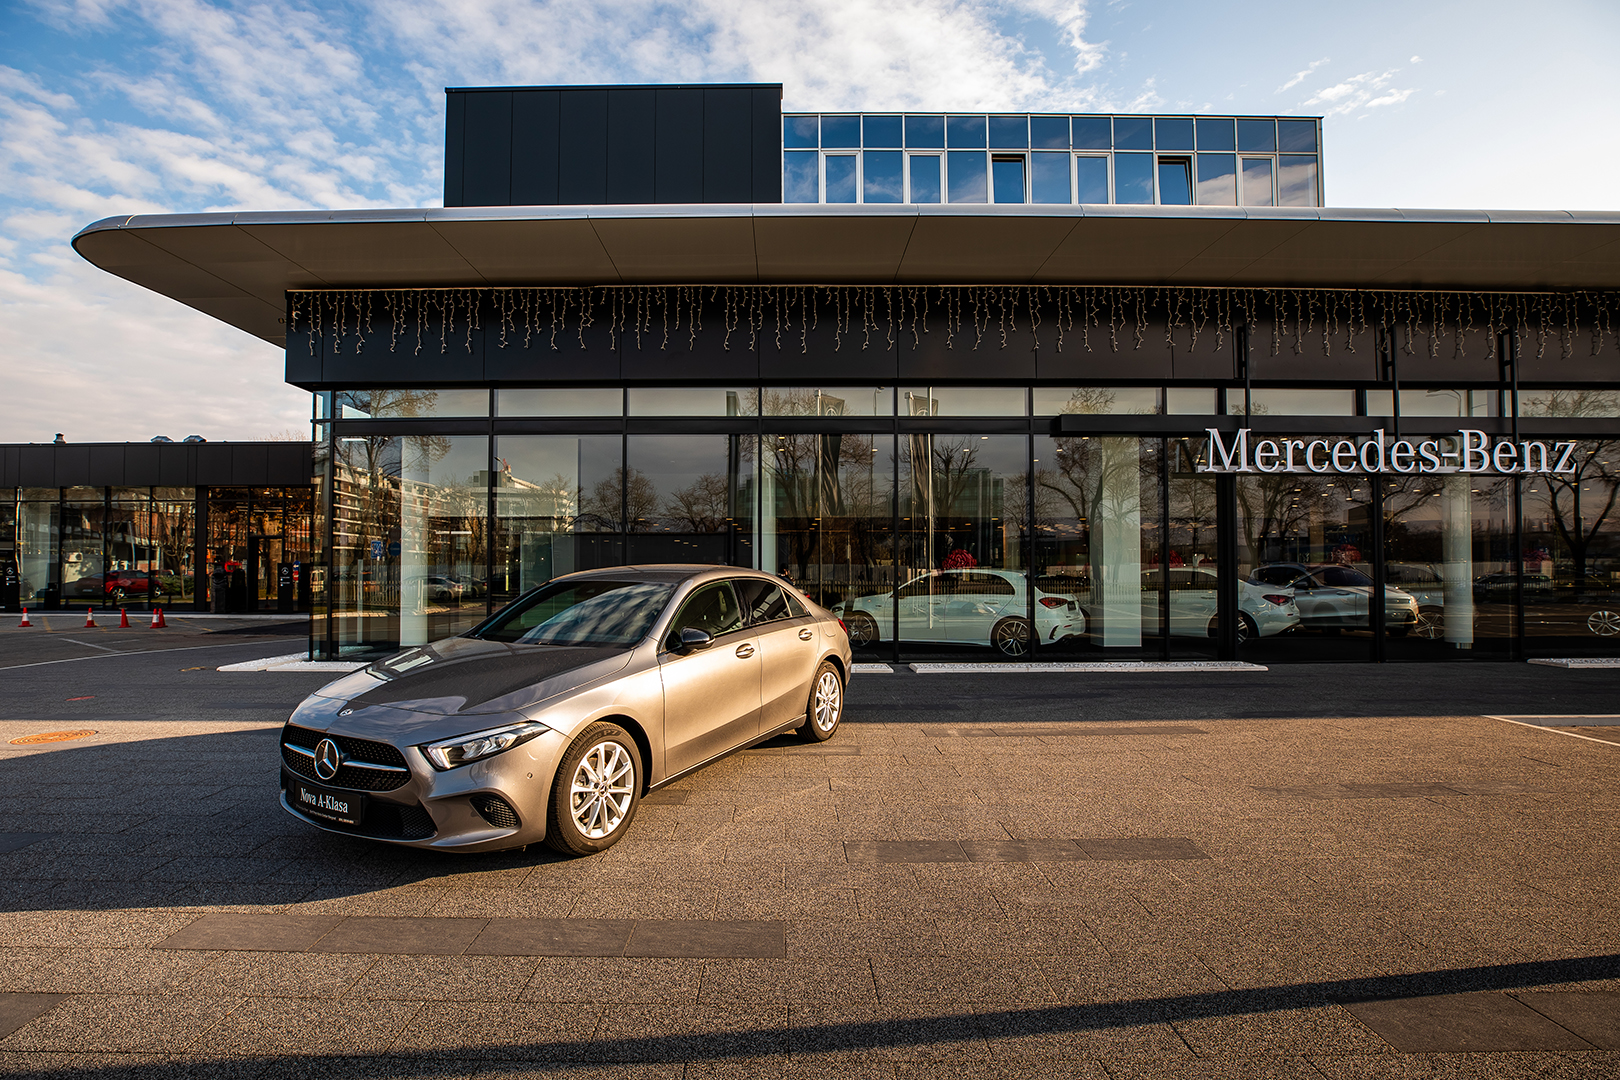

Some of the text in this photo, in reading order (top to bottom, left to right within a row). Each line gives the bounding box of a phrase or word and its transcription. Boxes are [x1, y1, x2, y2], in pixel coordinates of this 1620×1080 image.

[1204, 427, 1577, 474] Mercedes-Benz
[300, 787, 317, 806] Nova
[317, 793, 349, 814] A-Klasa
